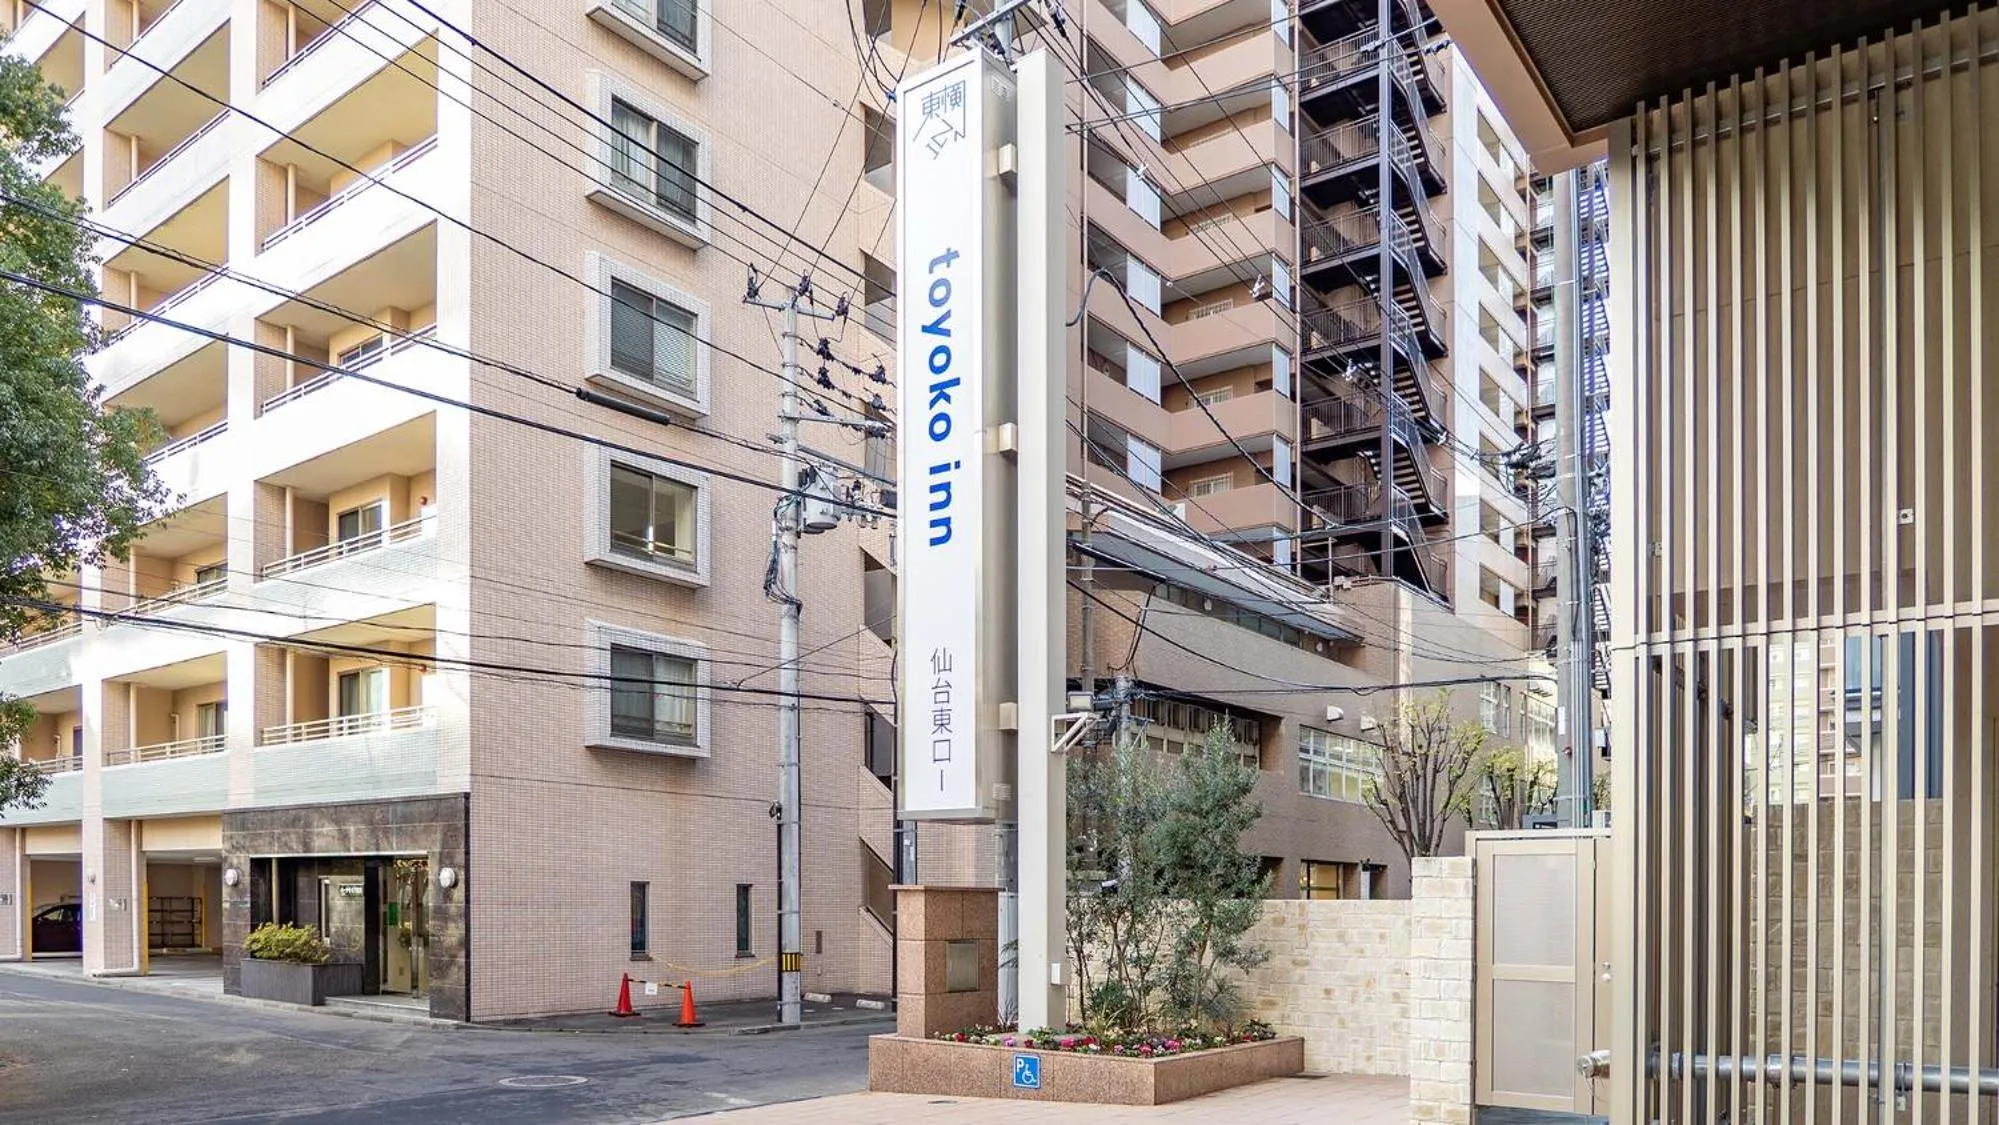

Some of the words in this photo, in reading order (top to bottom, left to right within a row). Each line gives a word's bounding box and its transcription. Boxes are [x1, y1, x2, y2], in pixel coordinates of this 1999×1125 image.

[921, 247, 961, 441] toyoko
[929, 460, 961, 547] inn
[1016, 1058, 1025, 1073] P
